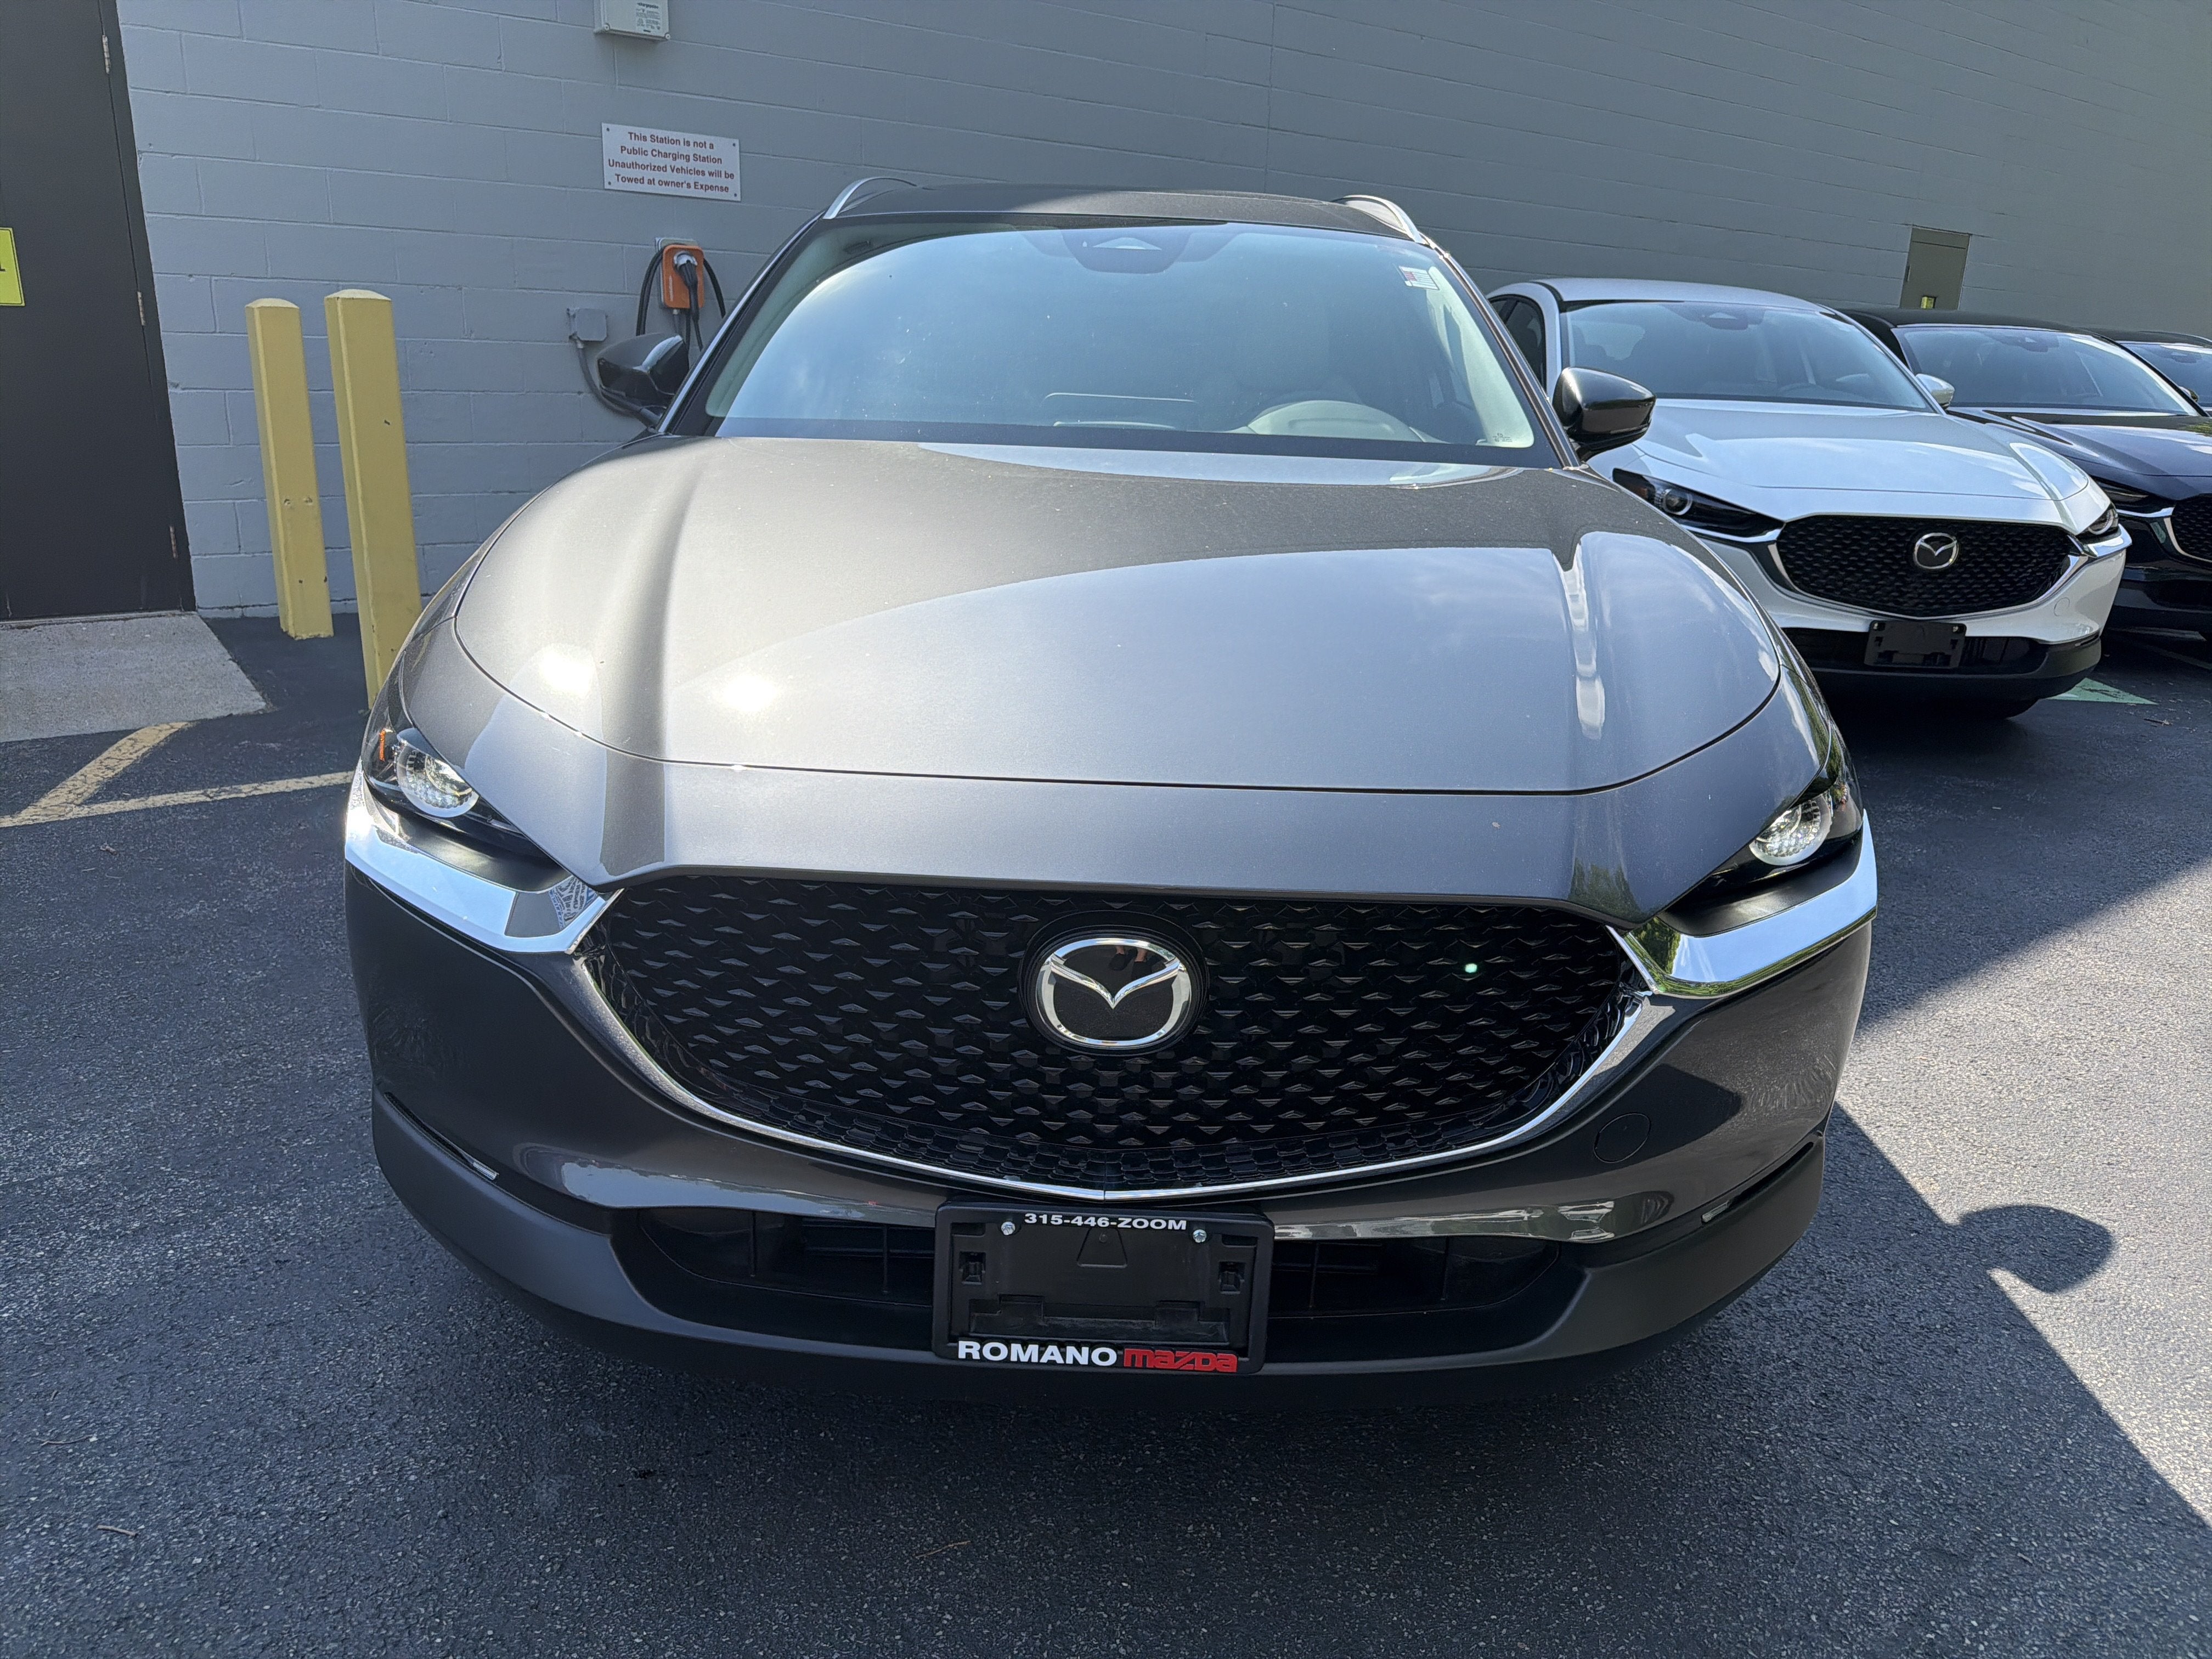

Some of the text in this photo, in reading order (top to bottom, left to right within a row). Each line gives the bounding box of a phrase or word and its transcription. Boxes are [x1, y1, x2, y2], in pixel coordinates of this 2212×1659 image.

[628, 132, 647, 142] This
[650, 134, 681, 146] Station
[683, 138, 691, 147] is
[693, 140, 707, 149] not
[620, 145, 723, 165] Public Charging Station
[608, 158, 735, 180] Unauthorized Vehicles will be
[614, 173, 729, 193] Towed at owner's Expense
[1024, 1212, 1187, 1231] 315-446-ZOOM
[958, 1340, 1118, 1367] ROMANO
